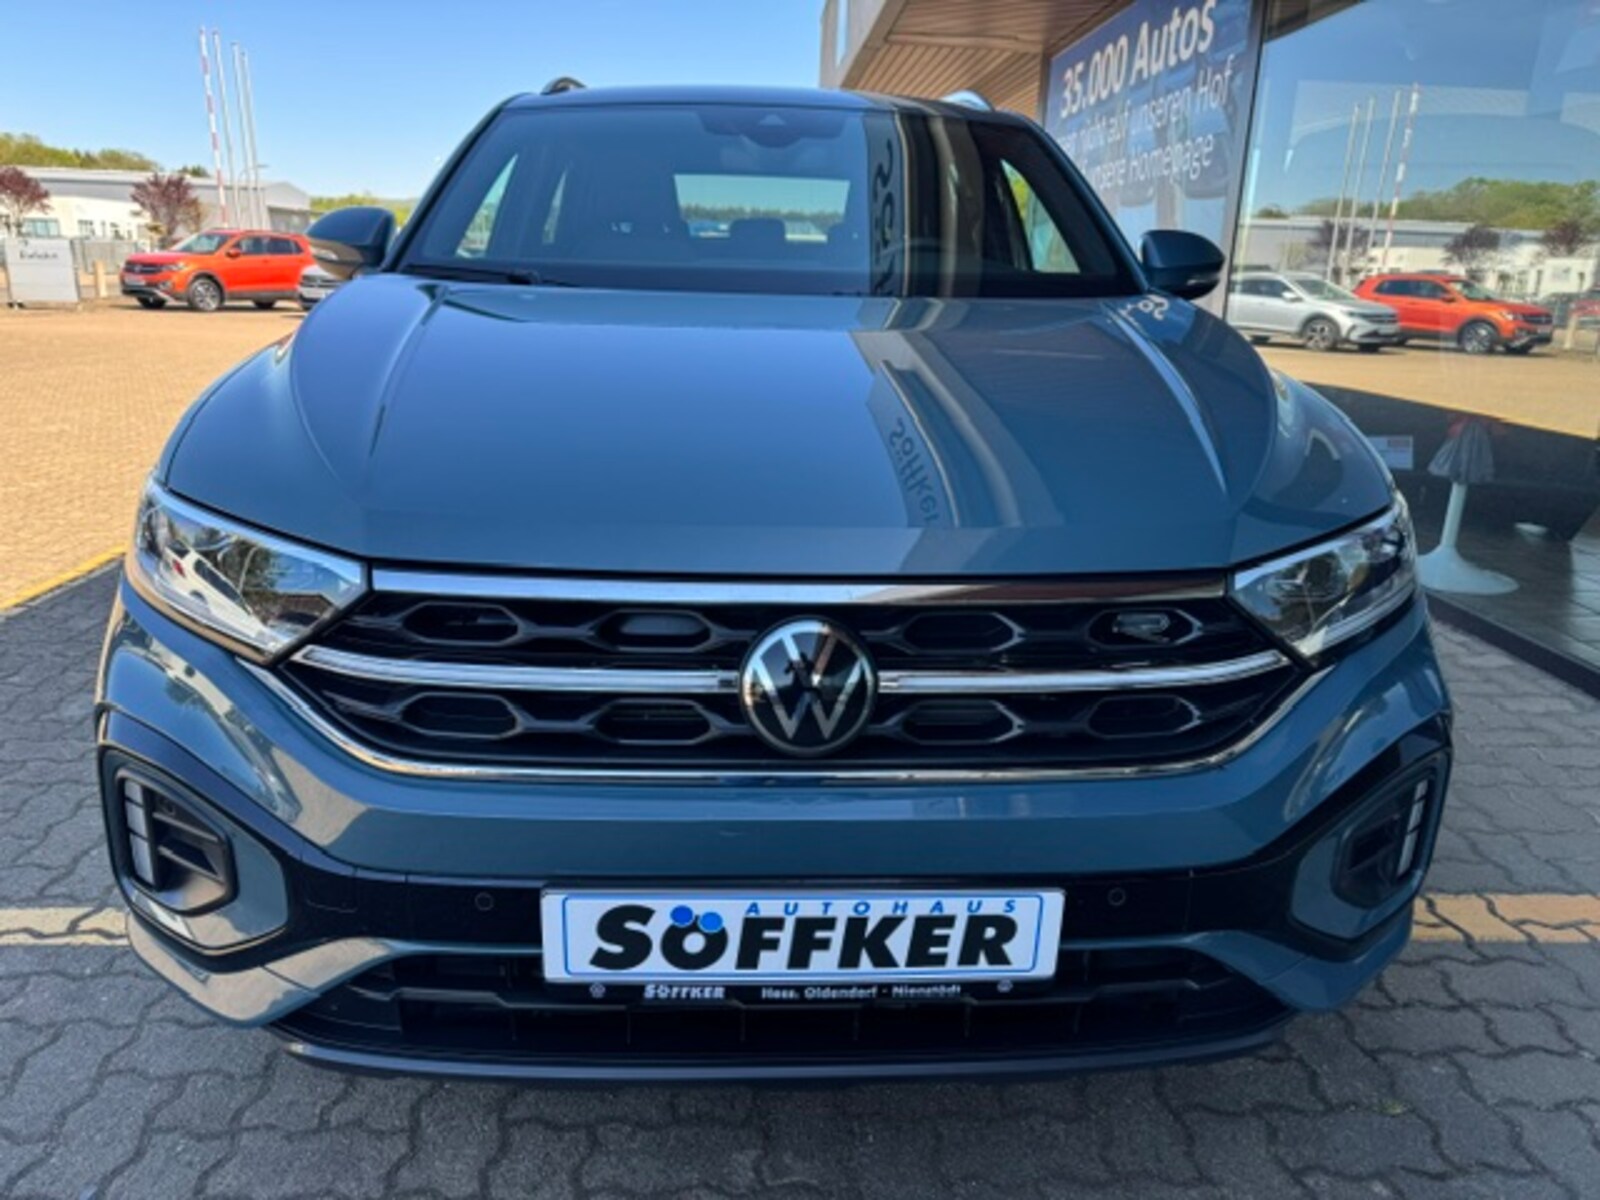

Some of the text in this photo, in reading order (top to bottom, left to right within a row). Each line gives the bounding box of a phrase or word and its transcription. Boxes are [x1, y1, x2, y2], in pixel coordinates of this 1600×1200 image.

[1060, 0, 1217, 118] 35.000 Autos
[1195, 54, 1235, 114] Hof
[589, 903, 1018, 971] SÖFFKER
[745, 899, 1018, 917] AUTOHAUS
[643, 984, 726, 999] SÖFFKER
[804, 986, 878, 999] Oldendorf
